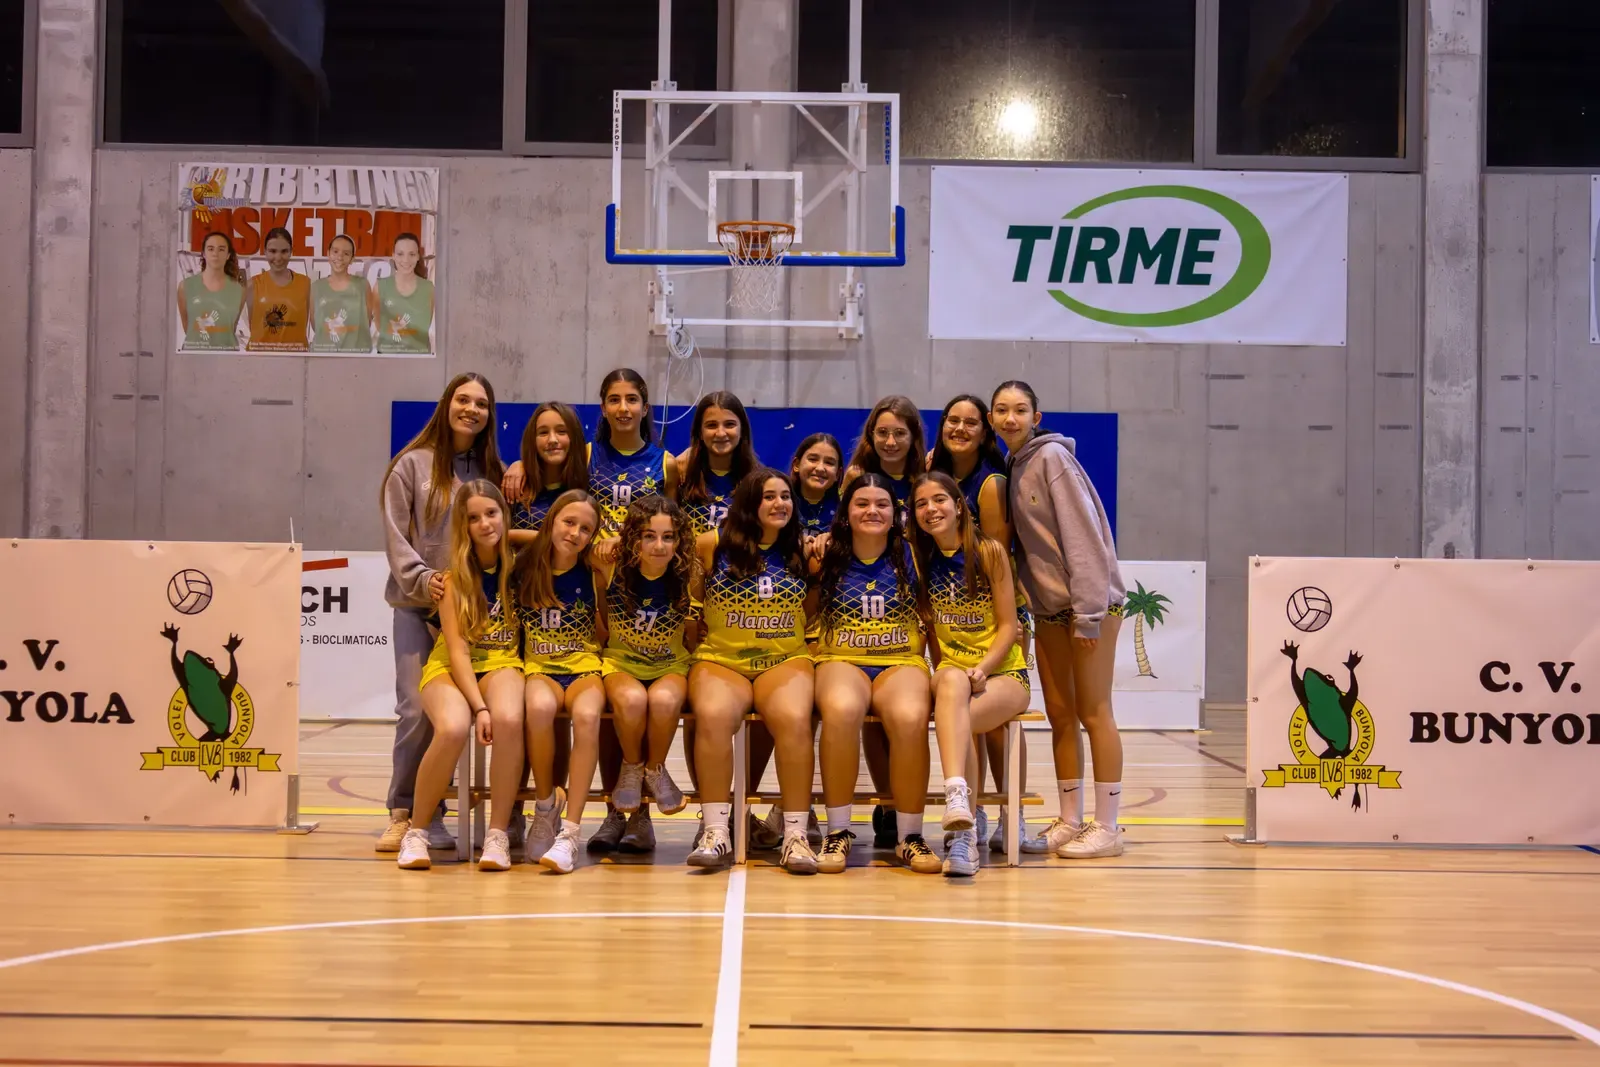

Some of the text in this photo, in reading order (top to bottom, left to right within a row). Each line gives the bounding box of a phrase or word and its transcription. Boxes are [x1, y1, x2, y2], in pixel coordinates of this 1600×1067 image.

[1006, 225, 1221, 286] TIRME
[612, 485, 631, 506] 19
[758, 575, 774, 600] 8
[541, 608, 562, 629] 18
[860, 595, 885, 619] 10
[634, 609, 658, 633] 27
[726, 611, 796, 630] Planells
[312, 634, 388, 645] BIOCLIMATICAS
[837, 626, 909, 649] Planells
[22, 639, 66, 671] V.
[1479, 660, 1581, 693] C. V.
[0, 691, 135, 724] YOLA
[172, 699, 185, 740] VOLEI
[231, 692, 251, 745] BUNYOLA
[1292, 716, 1306, 758] VOLEI
[1351, 709, 1371, 762] BUNYOLA
[171, 750, 196, 762] CLUB
[229, 751, 252, 763] 1982
[1292, 767, 1317, 779] CLUB
[1350, 768, 1372, 780] 1982
